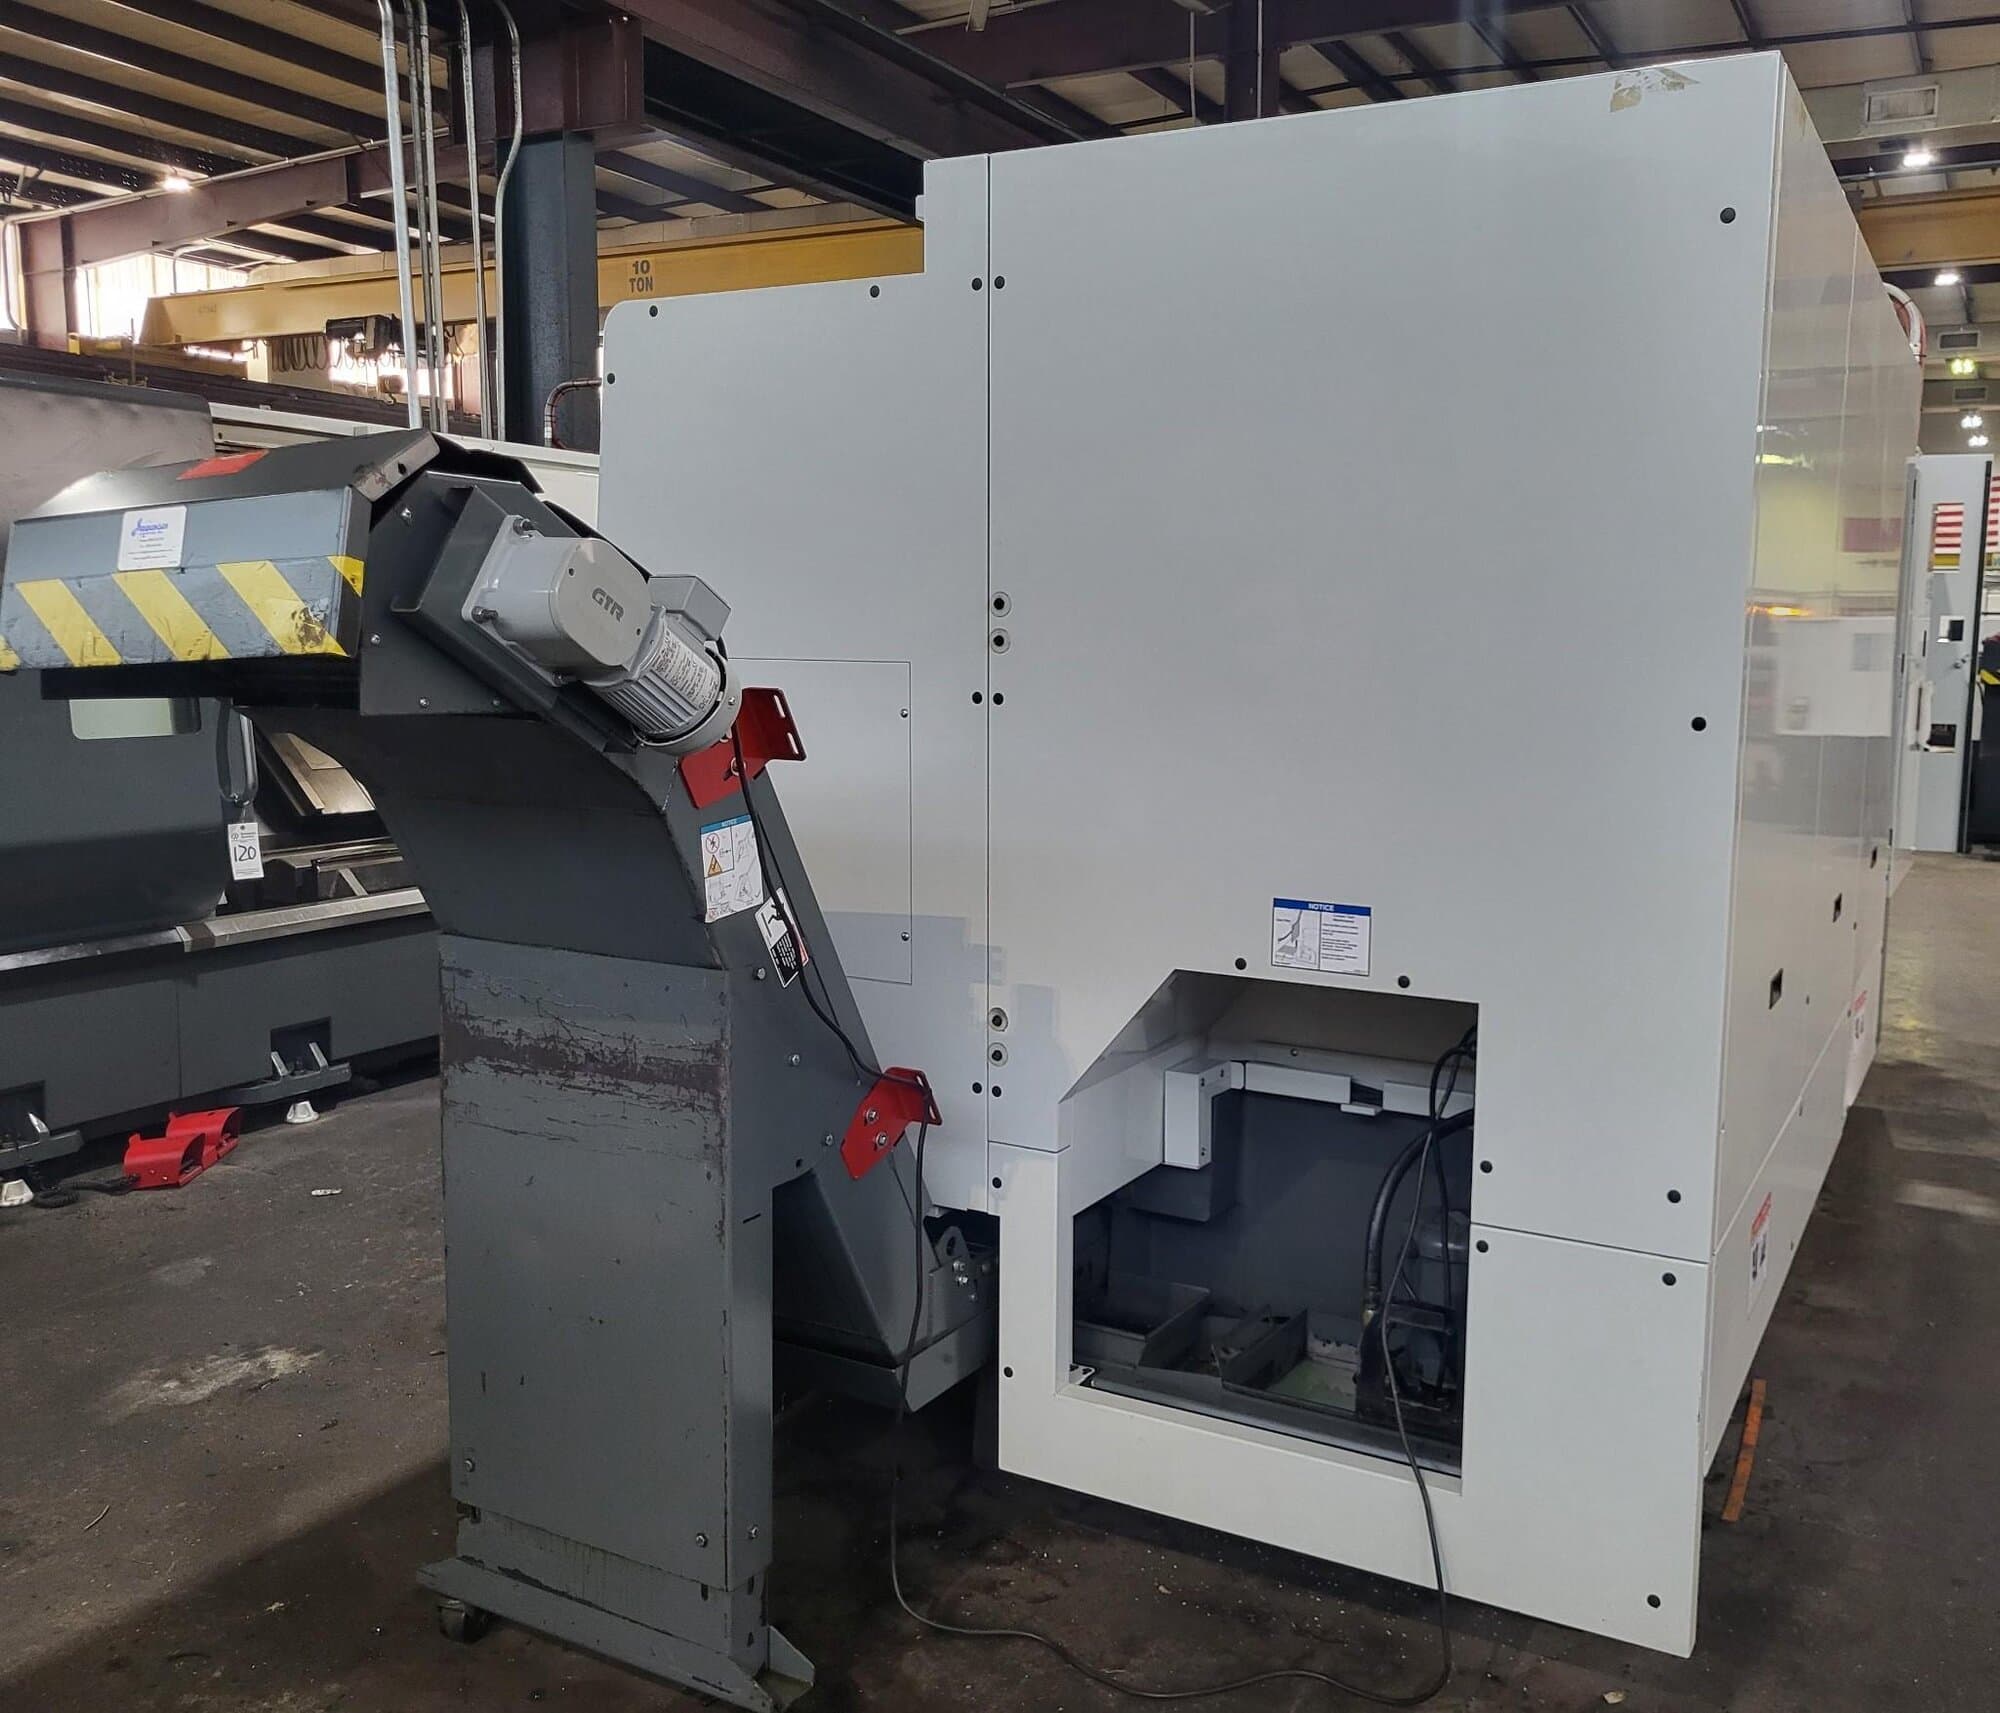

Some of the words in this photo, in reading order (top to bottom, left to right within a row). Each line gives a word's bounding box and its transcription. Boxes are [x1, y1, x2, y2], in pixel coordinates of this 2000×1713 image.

[632, 260, 650, 275] 10
[629, 276, 653, 293] TON
[591, 586, 624, 623] GTR
[233, 844, 257, 862] 120
[1308, 903, 1335, 912] NOTICE
